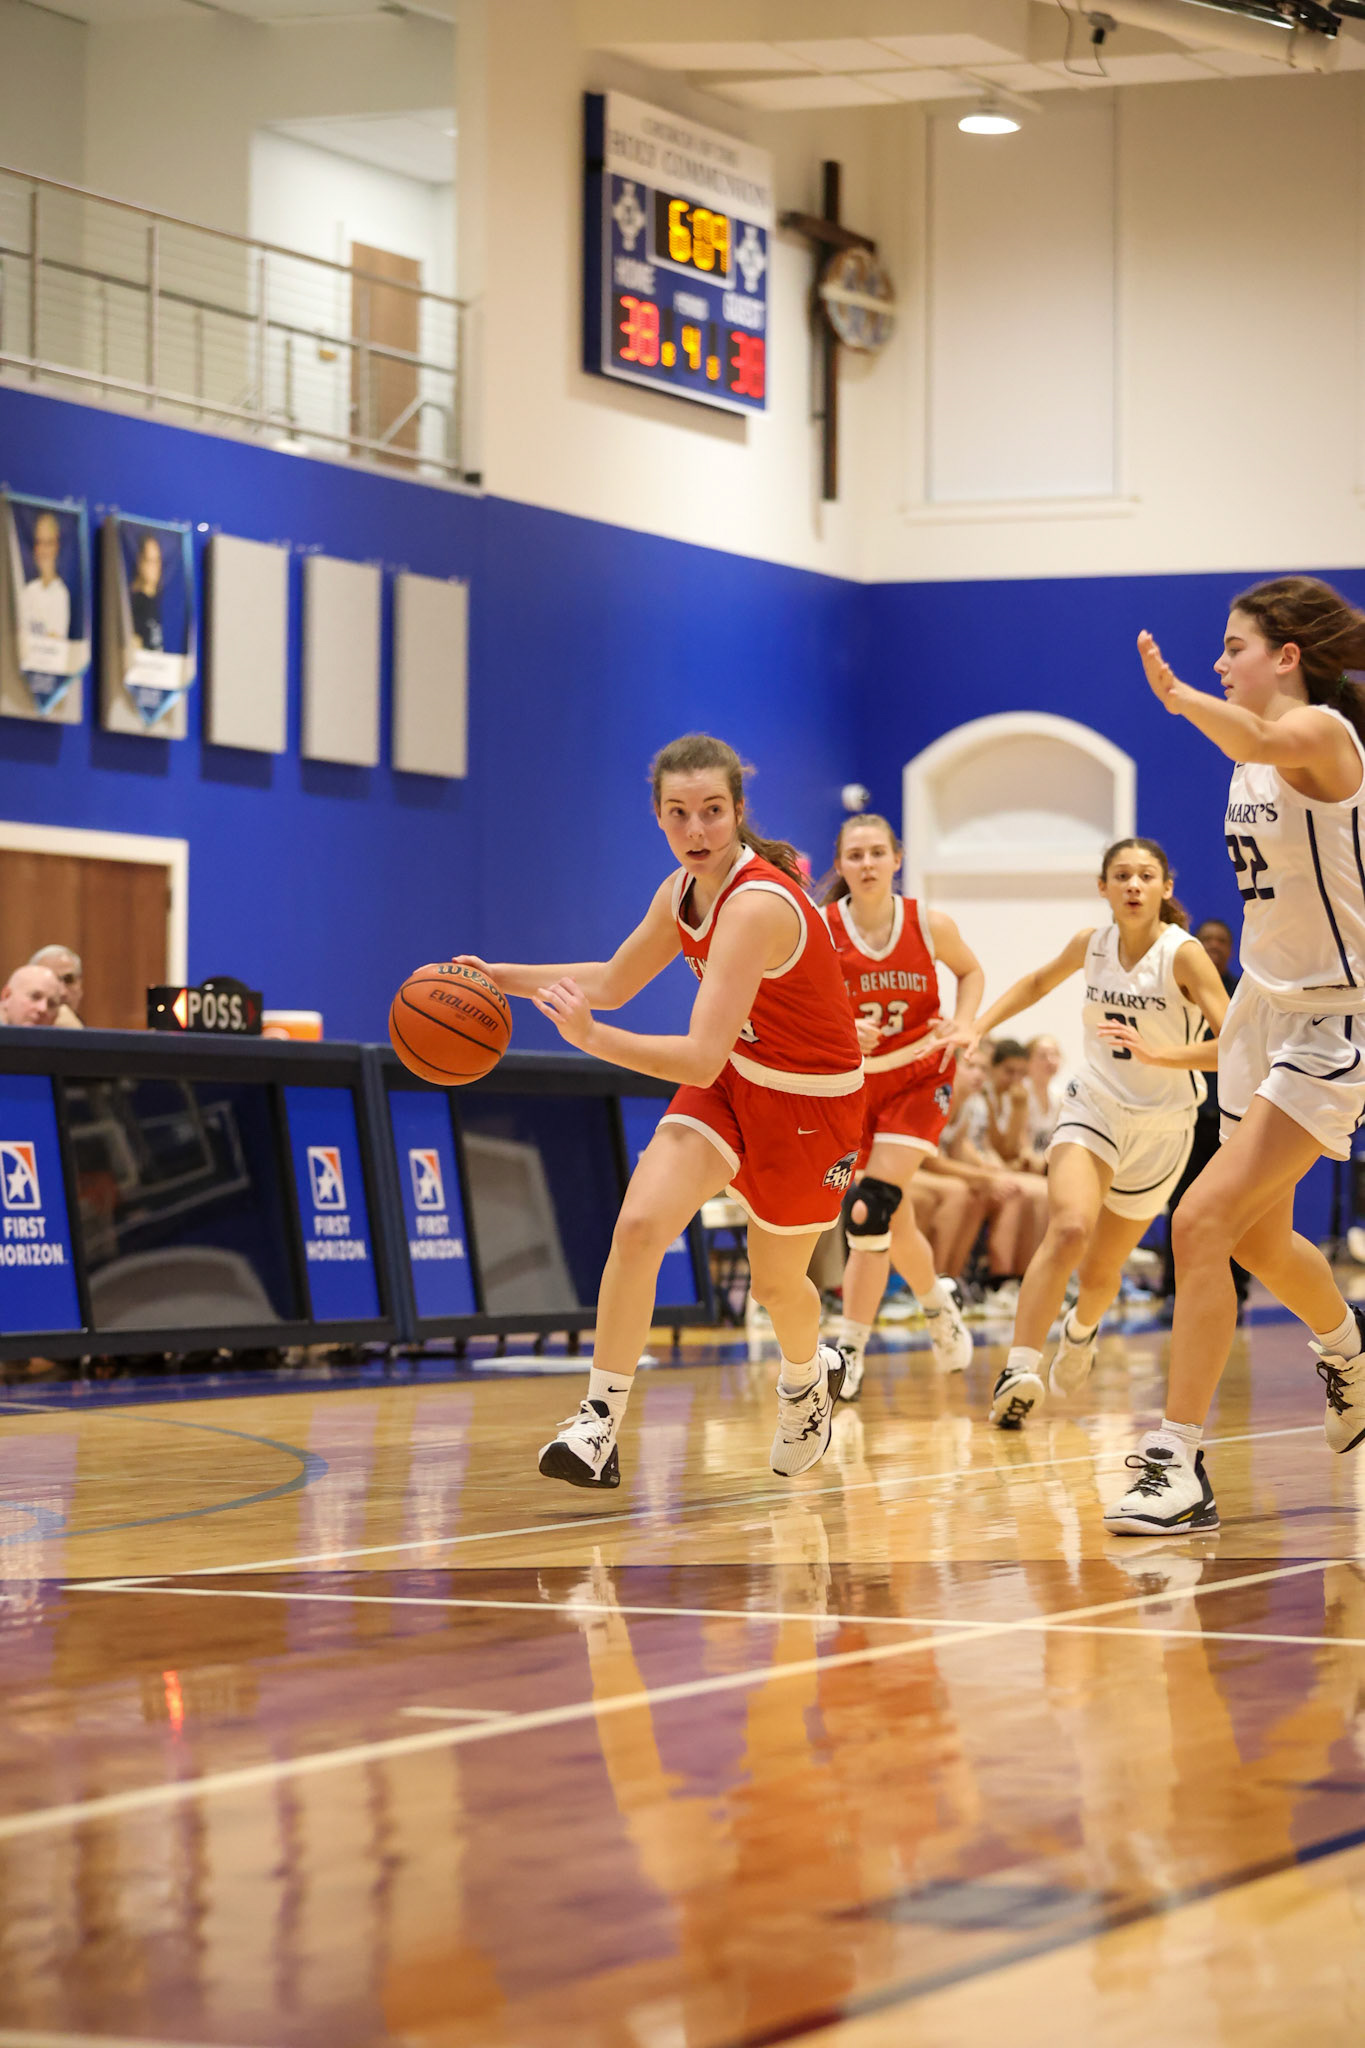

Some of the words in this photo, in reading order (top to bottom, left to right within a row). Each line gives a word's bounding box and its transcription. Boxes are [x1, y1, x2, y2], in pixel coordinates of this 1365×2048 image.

[1226, 802, 1278, 824] MARY'S
[1225, 834, 1275, 901] 22
[860, 968, 927, 993] BENEDICT
[188, 991, 247, 1030] POSS.
[429, 989, 499, 1031] EVOLUTION
[1101, 990, 1167, 1012] MARY'S
[823, 1164, 853, 1192] SBA
[3, 1216, 46, 1239] FIRST
[314, 1215, 350, 1236] FIRST
[416, 1215, 449, 1236] FIRST
[306, 1239, 367, 1261] HORIZON
[409, 1238, 465, 1261] HORIZON
